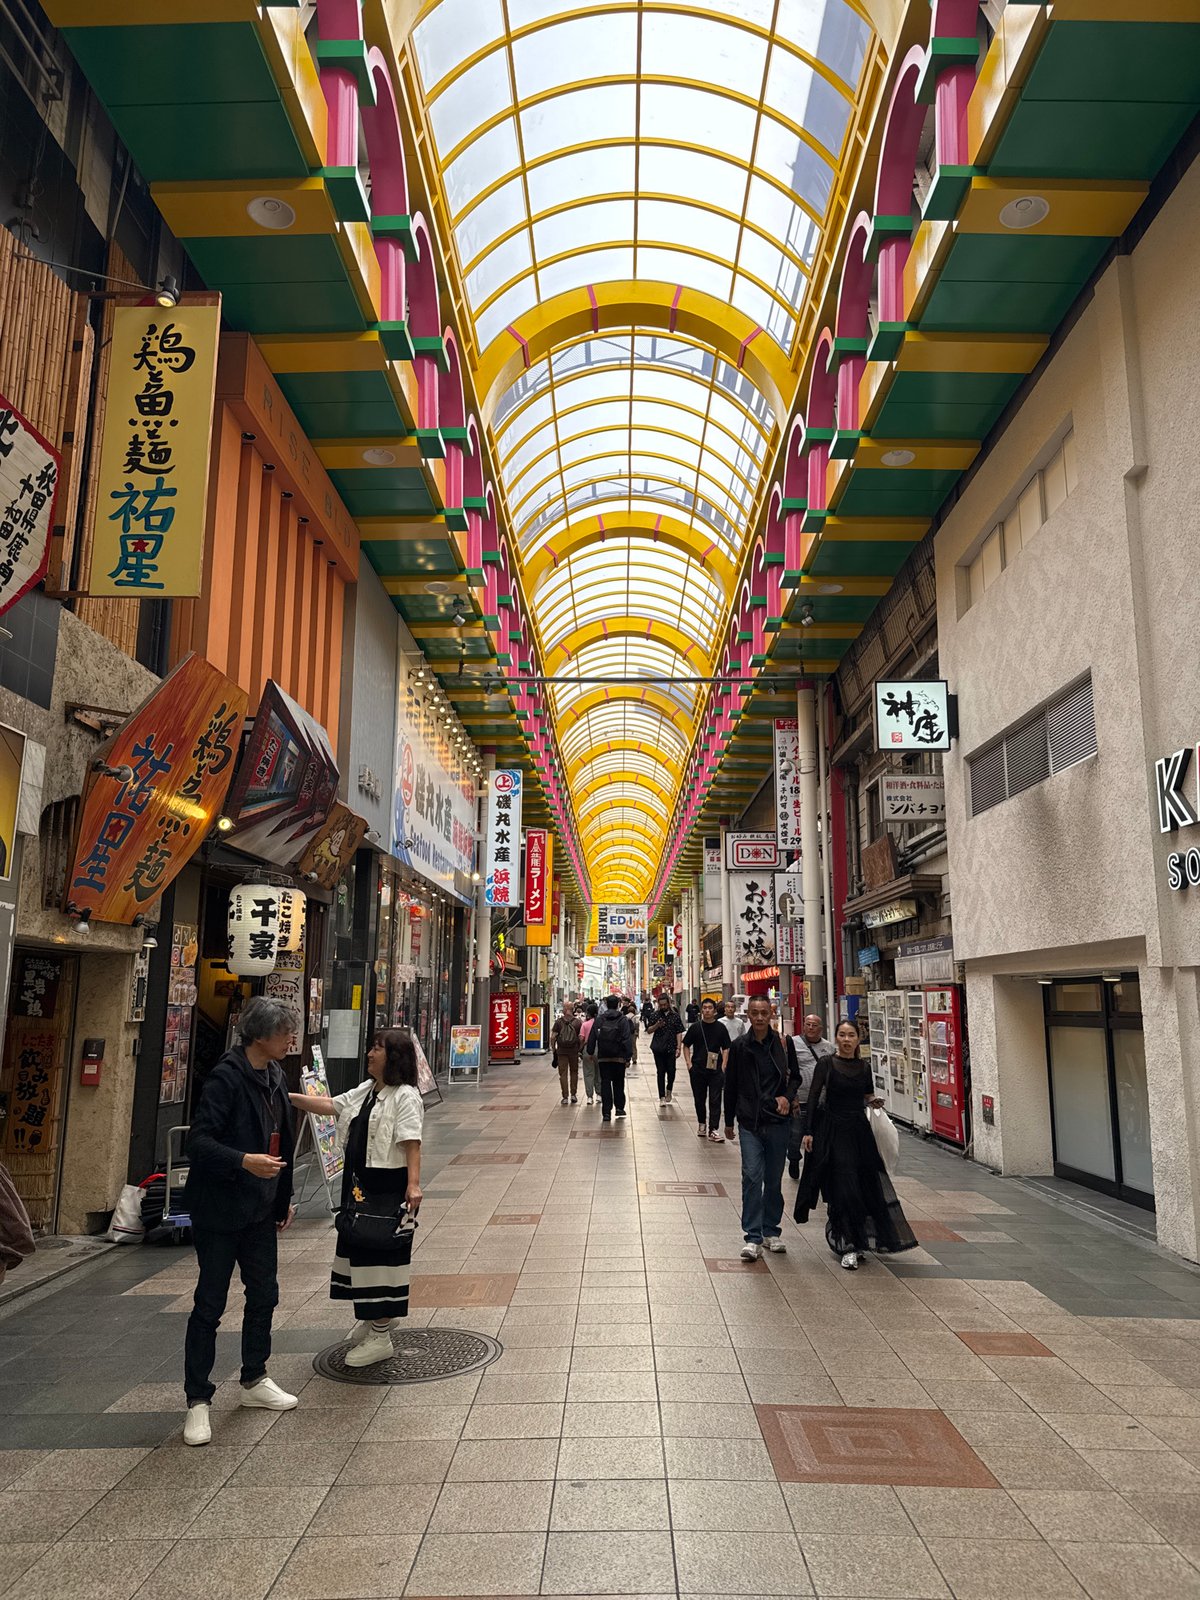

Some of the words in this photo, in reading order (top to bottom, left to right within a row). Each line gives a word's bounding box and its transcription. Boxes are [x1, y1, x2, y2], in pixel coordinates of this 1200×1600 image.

[122, 323, 196, 475] 鶏と魚と麺
[264, 383, 311, 484] RISE
[0, 461, 56, 593] 秋田県鹿角
[108, 476, 178, 589] 祐星
[880, 690, 945, 744] 神座
[1154, 742, 1200, 834] K
[494, 795, 512, 863] 磯丸水産
[493, 868, 511, 903] 浜焼
[598, 906, 608, 925] TAX
[248, 897, 277, 960] 千家
[277, 890, 293, 948] たこ焼き
[598, 926, 608, 944] FREE
[609, 915, 645, 929] EDION
[740, 880, 774, 960] お好み焼
[495, 1012, 509, 1044] ラーメン
